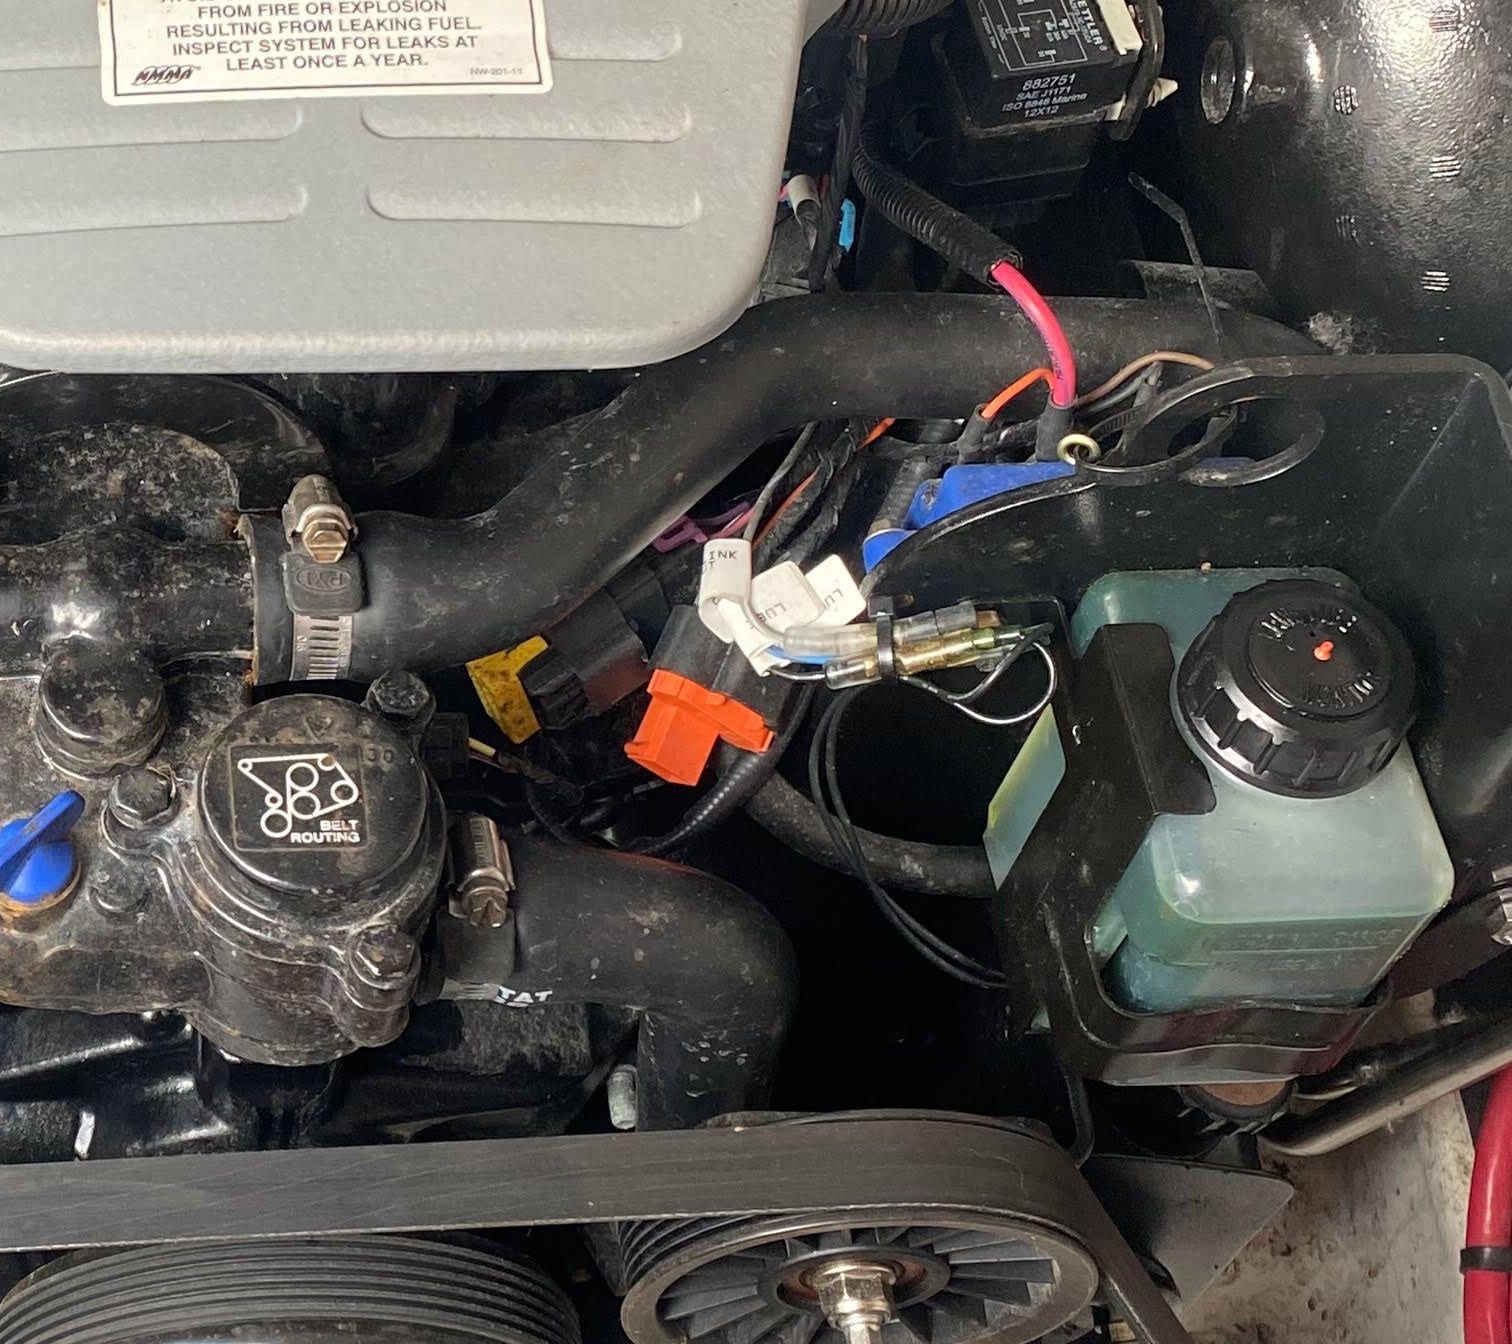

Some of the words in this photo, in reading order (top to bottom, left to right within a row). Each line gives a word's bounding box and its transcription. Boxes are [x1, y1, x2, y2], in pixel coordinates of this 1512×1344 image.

[197, 3, 252, 19] FROM
[257, 2, 300, 17] FIRE
[305, 1, 333, 15] OR
[338, 0, 448, 15] EXPLOSION
[166, 21, 272, 39] RESULTING
[278, 19, 333, 35] FROM
[338, 17, 422, 33] LEAKING
[427, 16, 482, 31] FUEL.
[172, 39, 254, 56] INSPECT
[259, 36, 336, 53] SYSTEM
[342, 35, 381, 51] FOR
[386, 34, 450, 50] LEAKS
[455, 34, 477, 49] AT
[225, 56, 287, 72] LEAST
[292, 54, 348, 70] ONCE
[353, 53, 366, 67] A
[371, 52, 430, 68] YEAR.
[1022, 72, 1076, 91] 882751
[1002, 102, 1023, 112] ISO
[1052, 93, 1088, 105] Marine
[1016, 89, 1039, 101] SAE
[1041, 86, 1072, 98] J1171
[319, 819, 359, 831] BELT
[291, 831, 361, 843] ROUTING
